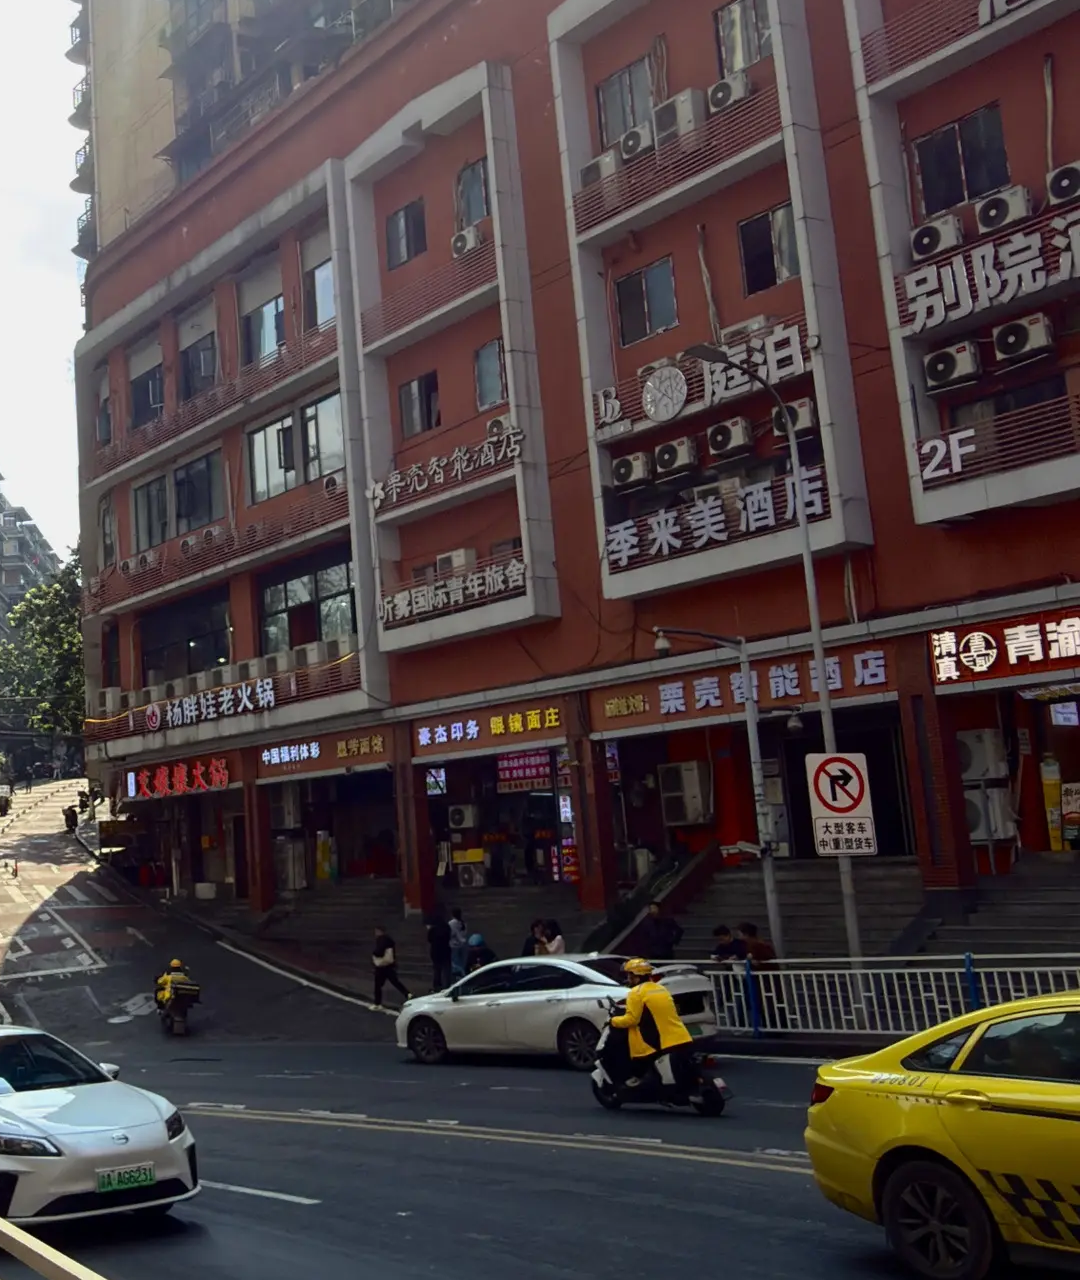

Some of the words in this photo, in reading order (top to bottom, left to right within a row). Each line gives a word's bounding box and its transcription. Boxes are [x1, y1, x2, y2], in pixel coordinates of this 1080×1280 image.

[919, 429, 978, 482] 2F
[606, 467, 824, 566] 季来美酒店
[377, 558, 526, 623] 听雾国际青年旅舍
[931, 630, 961, 682] 清真
[166, 678, 276, 727] 杨胖娃老火锅
[489, 707, 561, 736] 眼镜面庄
[261, 741, 321, 766] 中国福利体彩
[822, 821, 868, 835] 大型客车
